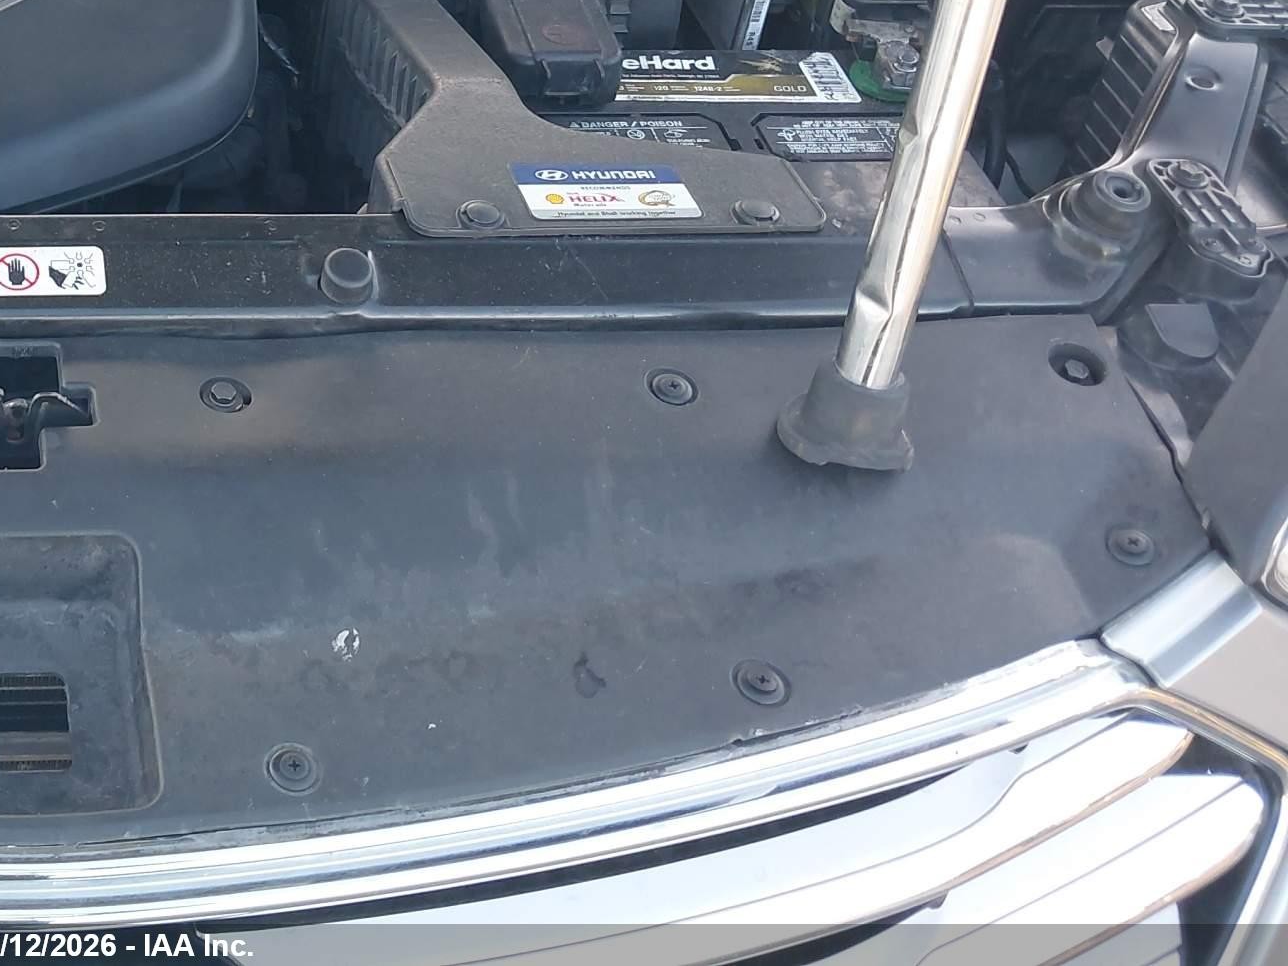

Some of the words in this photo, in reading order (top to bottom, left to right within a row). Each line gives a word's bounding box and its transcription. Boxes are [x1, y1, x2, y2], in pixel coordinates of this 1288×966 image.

[621, 55, 716, 70] eHard
[573, 170, 656, 179] HYUNDAI
[569, 194, 623, 202] HELIX
